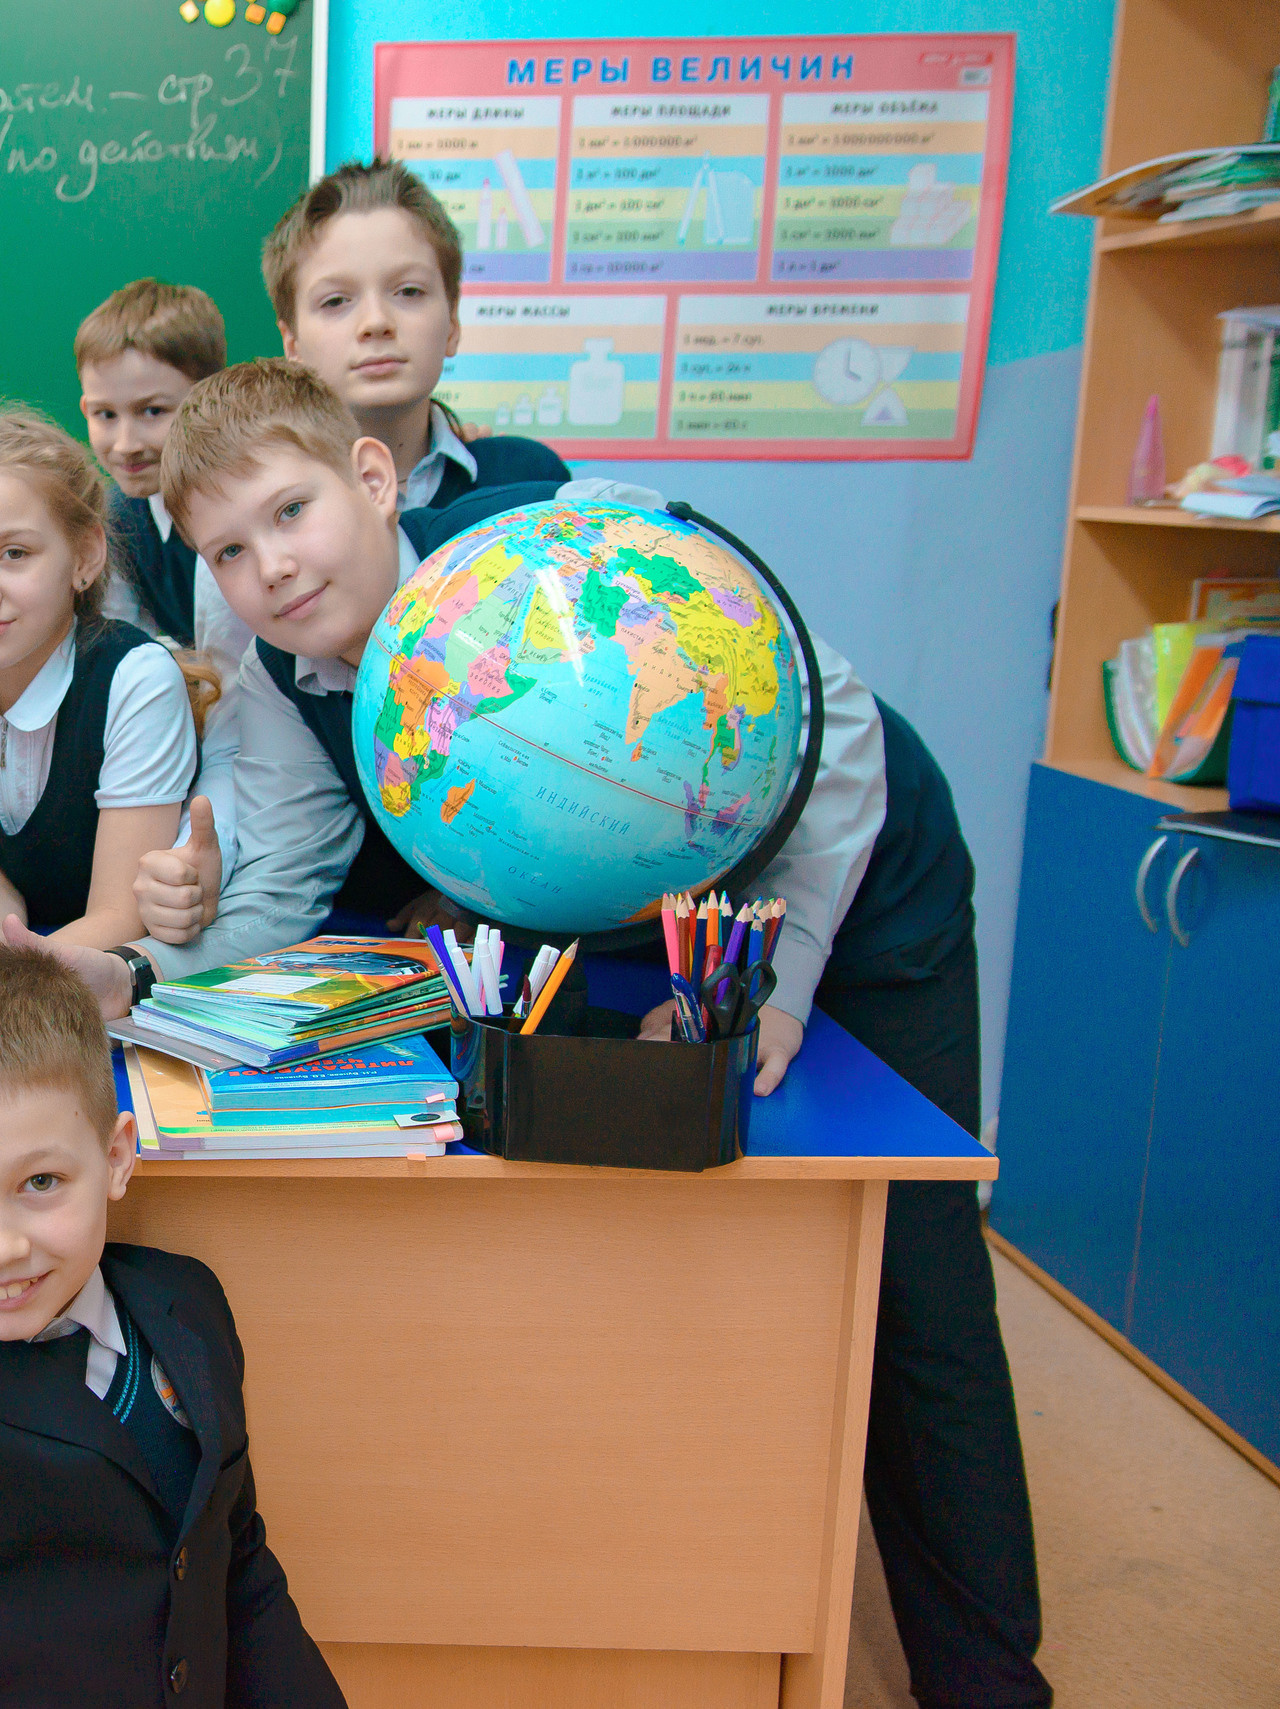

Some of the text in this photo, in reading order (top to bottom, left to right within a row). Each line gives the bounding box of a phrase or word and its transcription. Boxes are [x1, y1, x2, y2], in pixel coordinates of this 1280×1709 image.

[507, 54, 854, 85] МЕРЫ ВЕЛИЧИН
[535, 785, 631, 835] ИНДИЙСКИЙ
[507, 865, 562, 894] ОКЕАН
